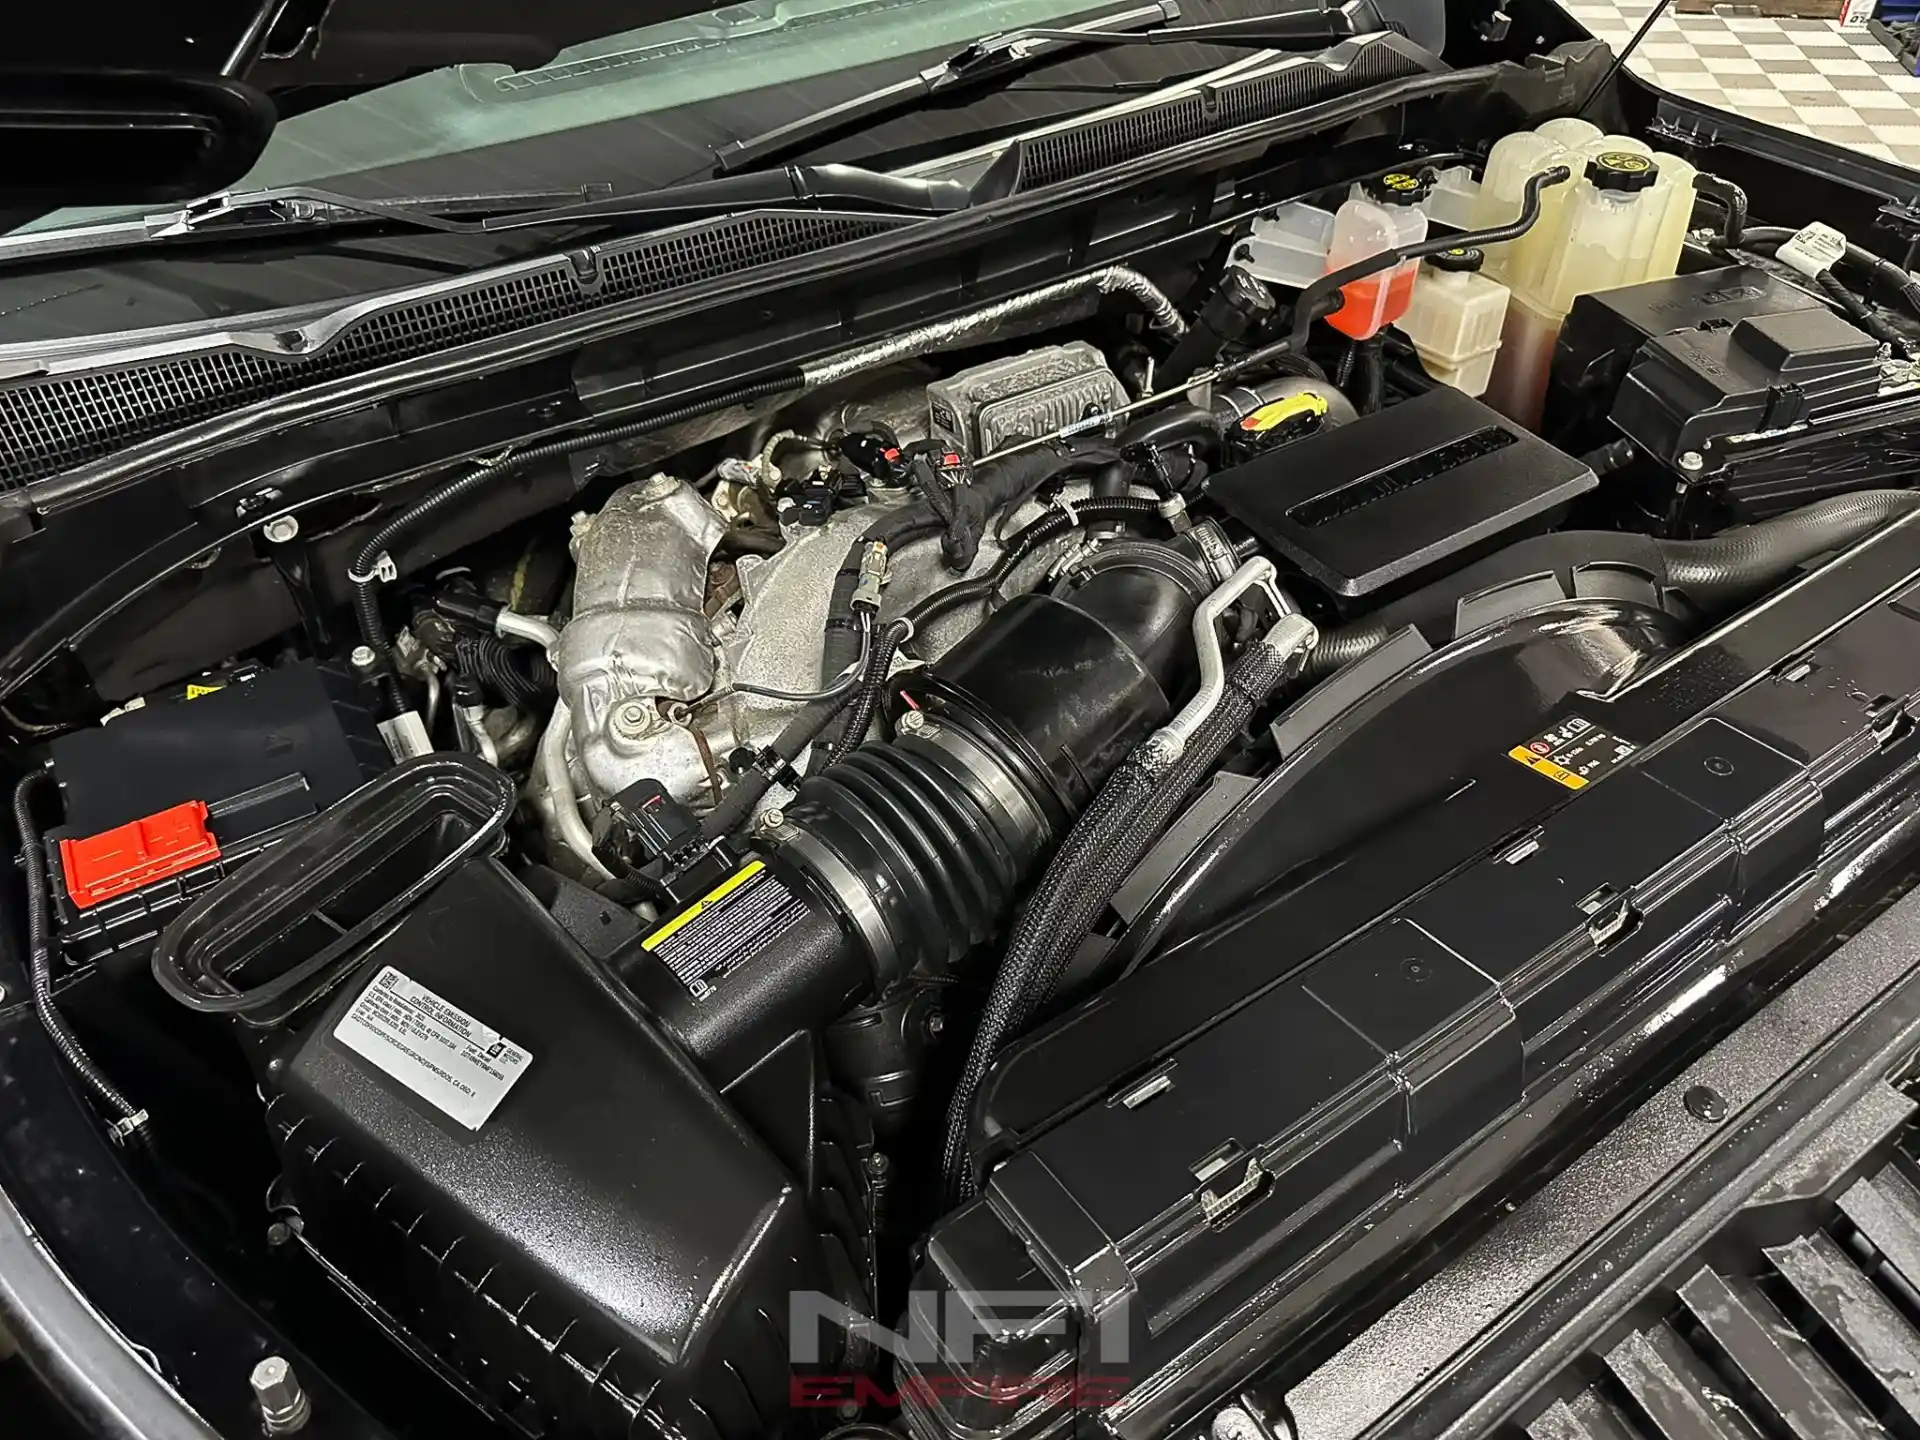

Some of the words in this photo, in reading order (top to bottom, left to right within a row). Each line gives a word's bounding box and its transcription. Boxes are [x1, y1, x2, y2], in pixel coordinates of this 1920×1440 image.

[409, 995, 436, 1014] CONTROL
[433, 1010, 472, 1037] INFORMATION
[420, 994, 445, 1012] VEHICLE
[442, 1007, 470, 1027] EMISSION
[505, 1047, 524, 1061] GENERAL
